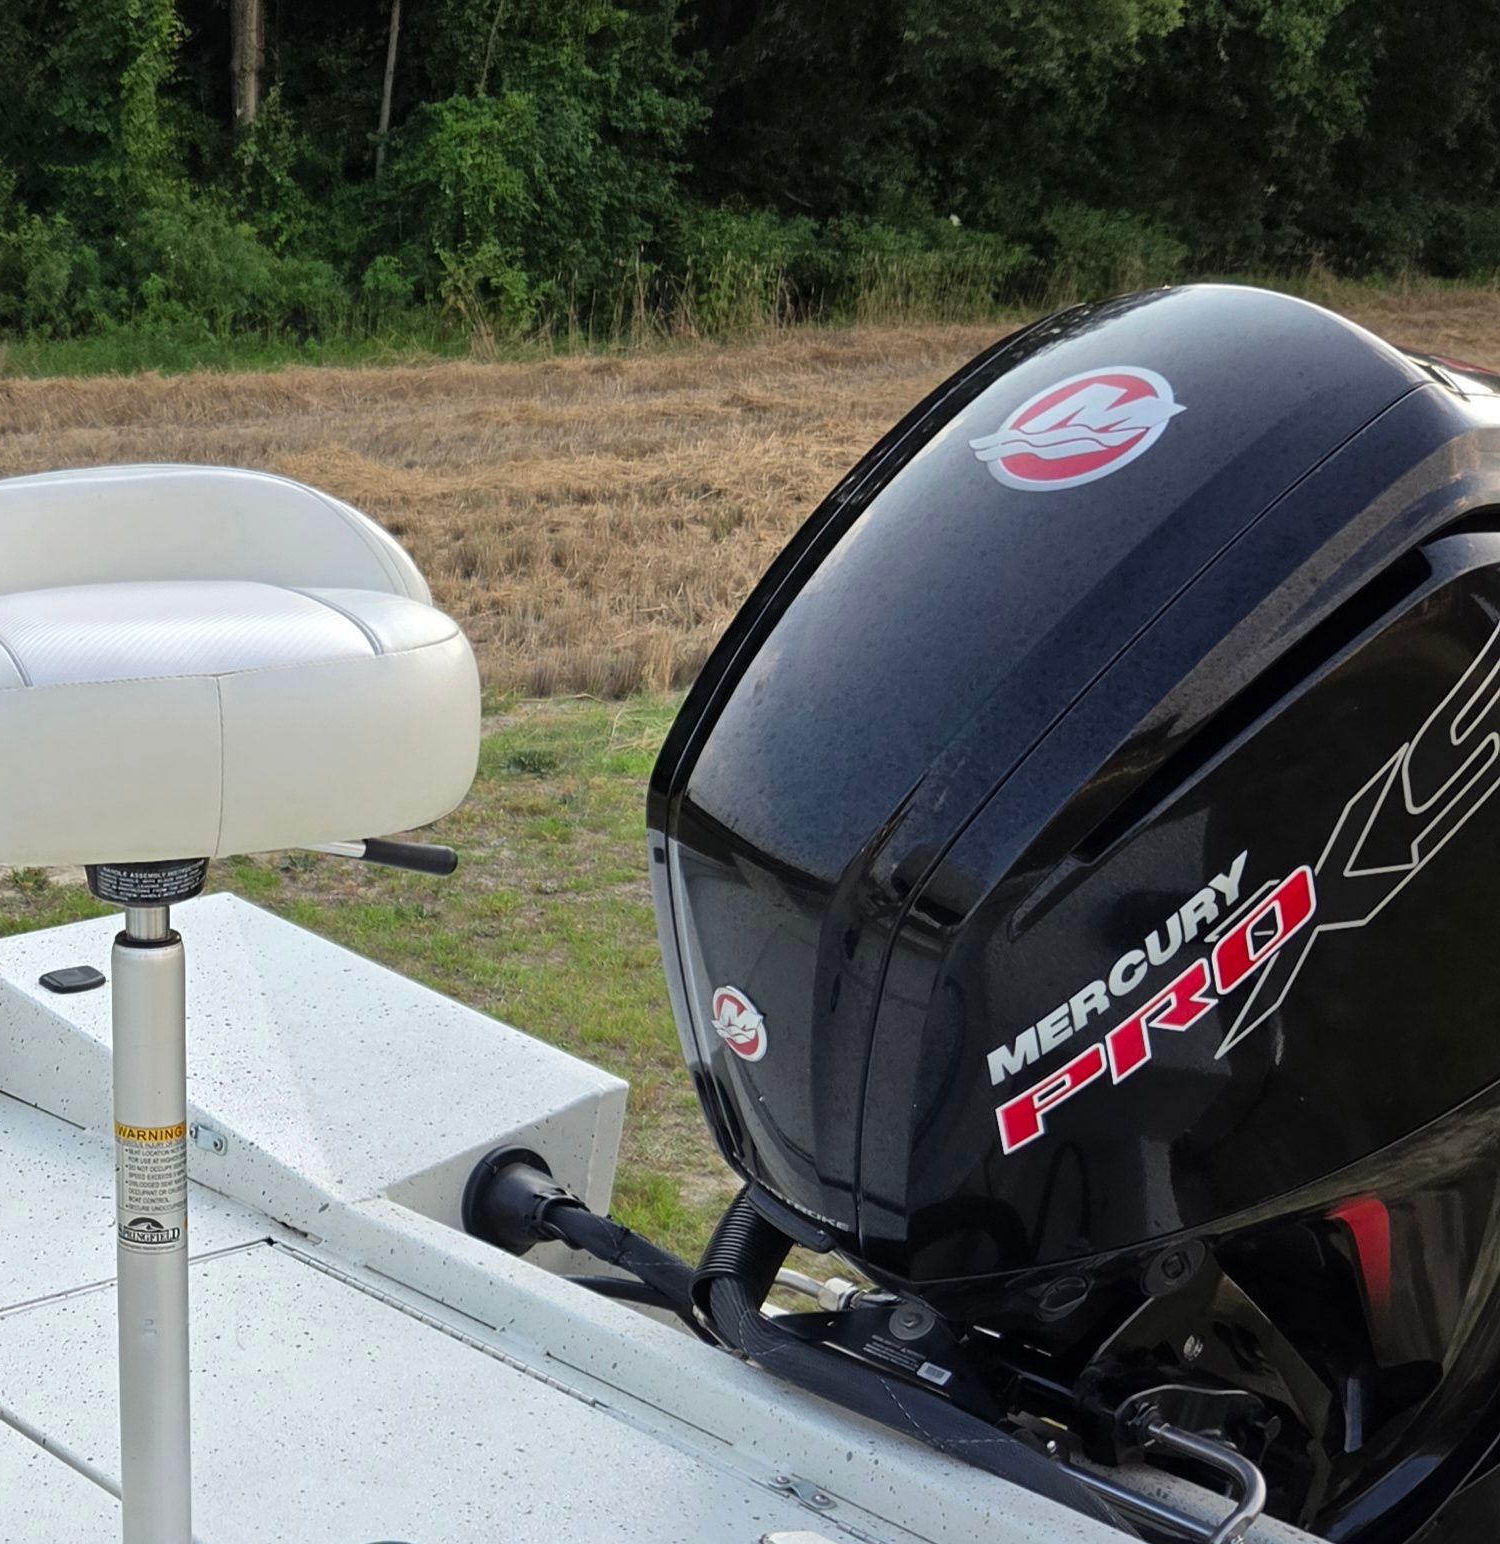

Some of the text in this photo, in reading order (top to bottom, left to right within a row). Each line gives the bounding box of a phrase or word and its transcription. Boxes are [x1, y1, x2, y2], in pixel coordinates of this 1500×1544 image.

[130, 871, 167, 879] ASSEMBLY
[986, 850, 1248, 1086] MERCURY
[995, 864, 1317, 1156] PRO
[117, 1125, 183, 1141] WARNING
[142, 1149, 169, 1157] LOCATION
[118, 1223, 180, 1243] SPRINGFIELD
